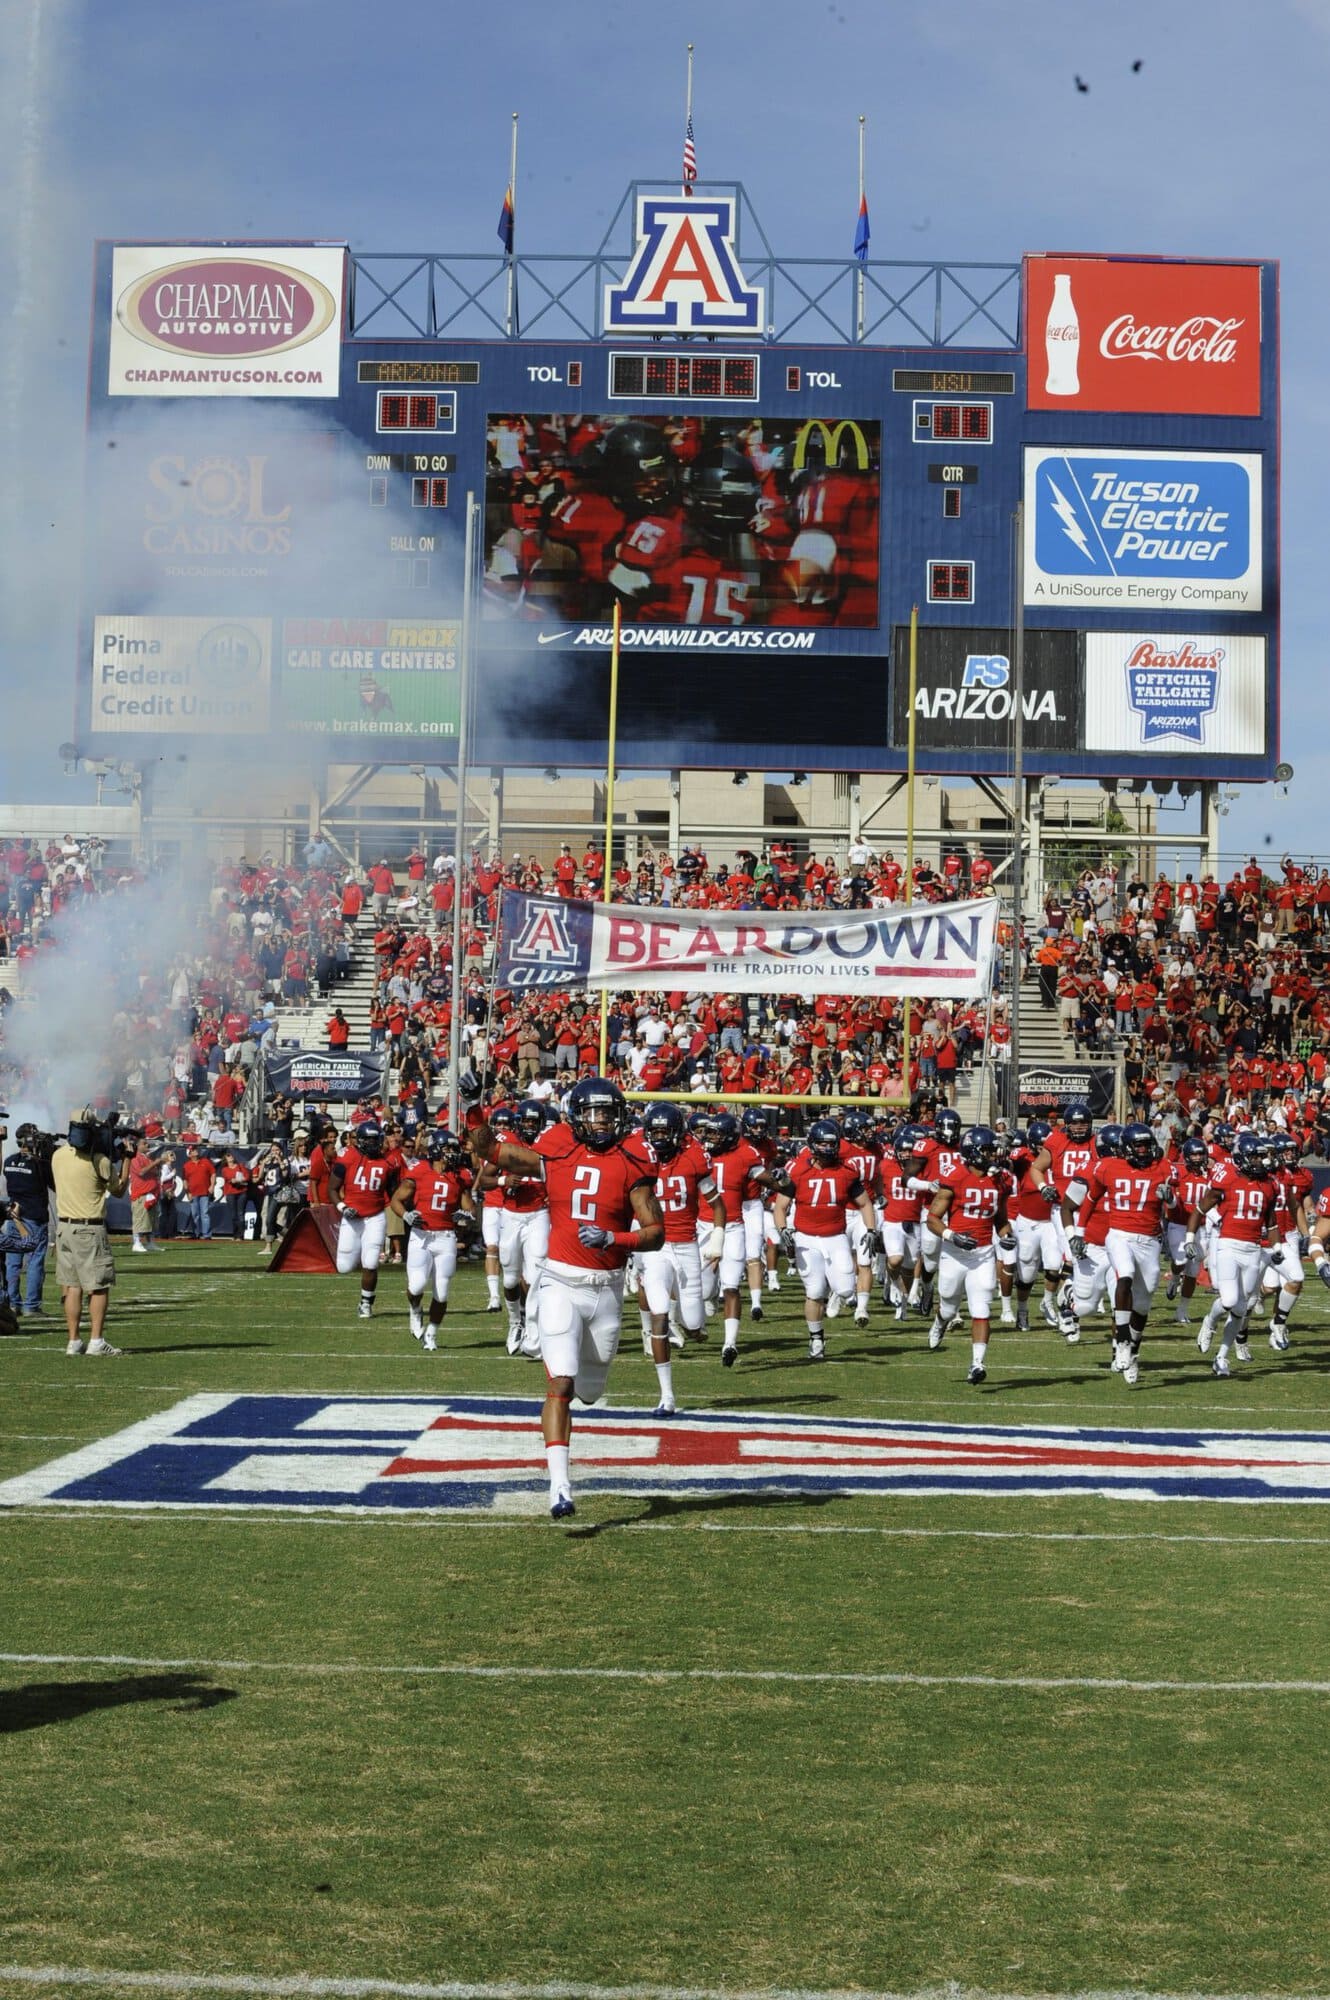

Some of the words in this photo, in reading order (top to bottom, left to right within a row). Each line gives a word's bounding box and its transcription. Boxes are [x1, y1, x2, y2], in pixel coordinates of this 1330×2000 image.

[155, 283, 297, 320] CHAPMAN
[158, 321, 294, 336] AUTOMOTIVE
[1100, 314, 1246, 363] Coca-Cola
[124, 369, 323, 384] CHAPMANTUCSON.COM
[378, 362, 460, 382] ARIZONA
[527, 366, 562, 383] TOL
[646, 358, 754, 395] 4:52
[806, 371, 842, 388] TOL
[367, 455, 391, 471] DWN
[414, 455, 428, 471] TO
[431, 455, 448, 471] GO
[942, 465, 964, 483] QTR
[1090, 472, 1200, 504] Tucson
[1101, 502, 1230, 533] Electric
[142, 524, 293, 555] CASINOS
[391, 536, 416, 552] BALL
[418, 536, 435, 552] ON
[1114, 531, 1229, 561] Power
[1034, 582, 1046, 595] A
[1049, 583, 1123, 597] UniSource
[1127, 584, 1177, 601] Energy
[1181, 585, 1249, 602] Company
[102, 634, 162, 655] Pima
[573, 628, 816, 650] ARIZONAWILDCATS.COM
[287, 650, 323, 669] CAR
[329, 650, 375, 670] CARE
[380, 650, 457, 671] CENTERS
[101, 665, 192, 686] Federal
[1135, 673, 1212, 686] OFFICIAL
[1135, 686, 1212, 699] TAILGATE
[1135, 699, 1210, 707] HEADQUARTERS
[100, 695, 176, 716] Credit
[906, 688, 1058, 722] ARIZONA
[1147, 715, 1198, 726] ARIZONA
[712, 962, 738, 974] THE
[744, 963, 824, 976] TRADITION
[830, 965, 870, 977] LIVES
[292, 1063, 331, 1071] AMERICAN
[333, 1063, 361, 1071] FAMILY
[1020, 1078, 1060, 1086] AMERICAN
[1062, 1078, 1091, 1086] FAMILY
[354, 1166, 384, 1192] 46
[713, 1162, 726, 1194] 1
[430, 1181, 450, 1212] 2
[571, 1165, 601, 1222] 2
[807, 1178, 838, 1208] 71
[963, 1187, 999, 1220] 23
[1114, 1178, 1152, 1212] 27
[1233, 1189, 1264, 1221] 19
